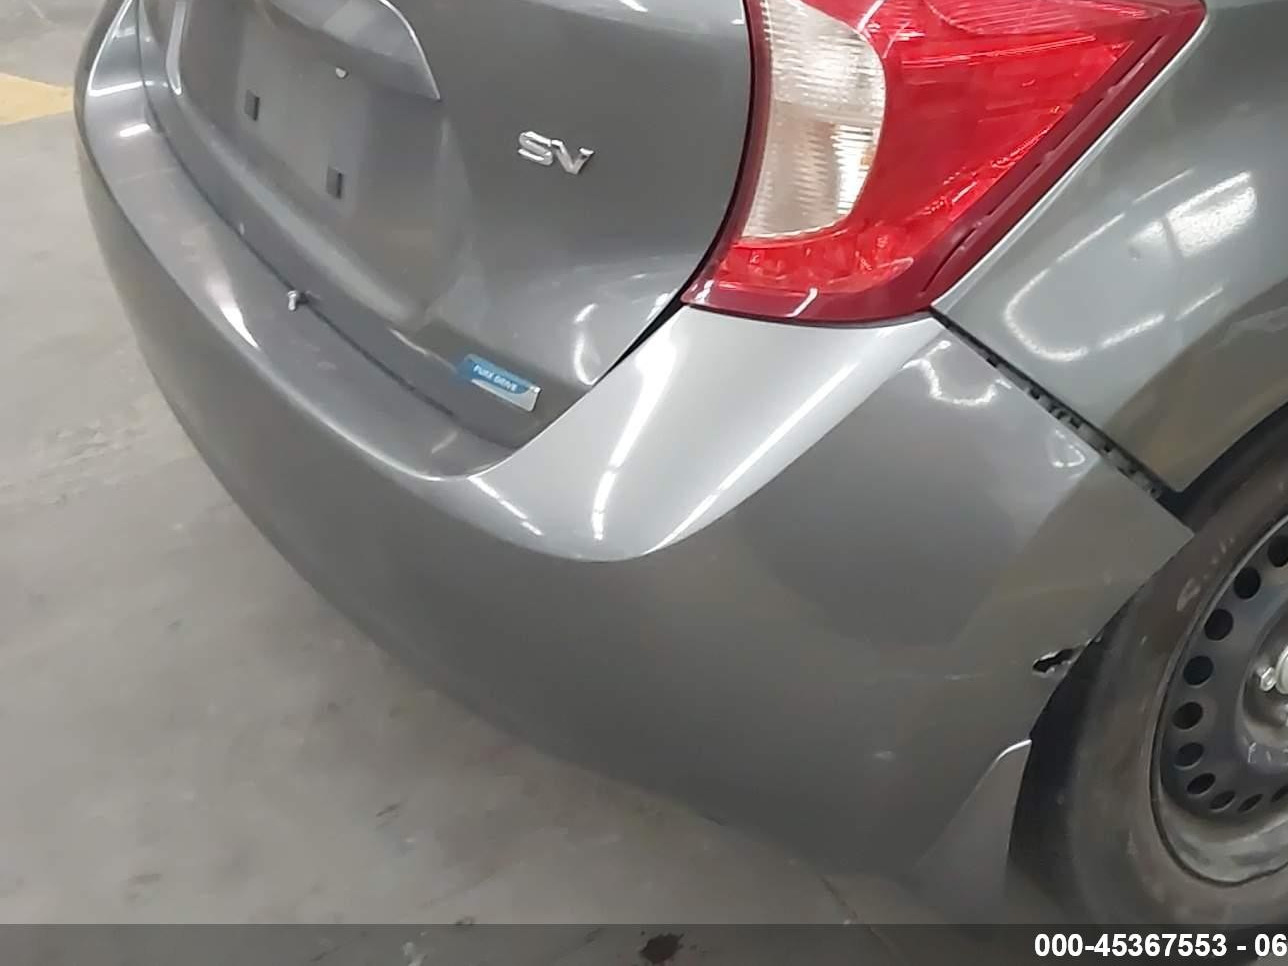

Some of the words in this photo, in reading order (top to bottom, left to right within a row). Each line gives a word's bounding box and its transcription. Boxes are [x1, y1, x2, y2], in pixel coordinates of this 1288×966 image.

[517, 130, 596, 176] SV
[473, 364, 495, 379] PURE
[492, 374, 518, 392] DRIVE
